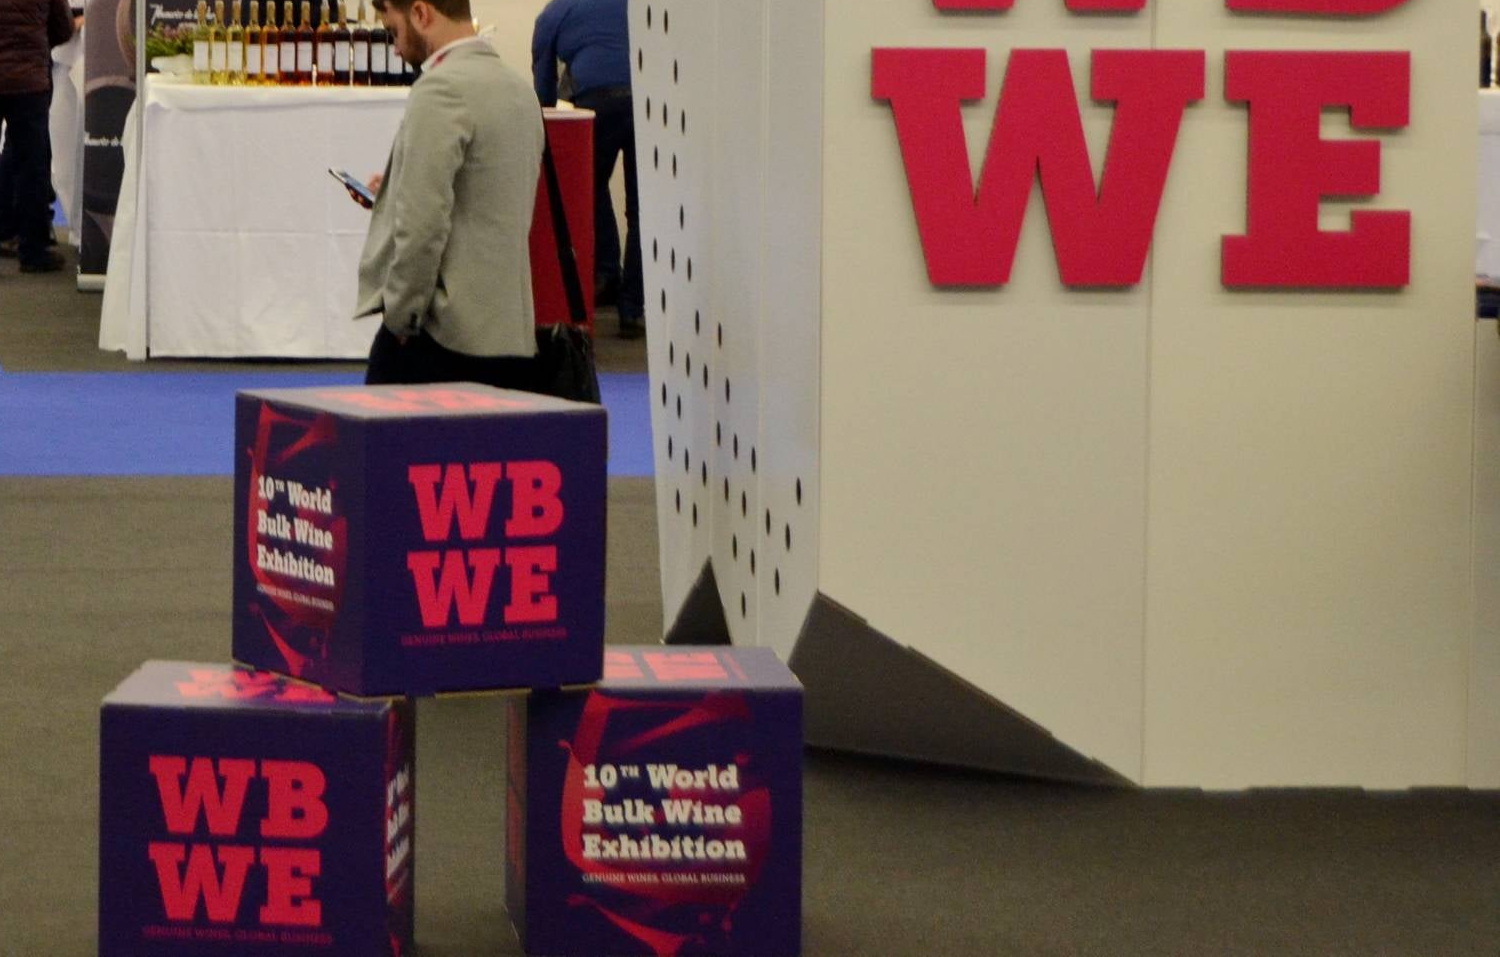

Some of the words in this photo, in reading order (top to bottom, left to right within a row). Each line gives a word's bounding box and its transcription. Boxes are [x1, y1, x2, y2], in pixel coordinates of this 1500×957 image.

[871, 46, 1412, 289] WE
[257, 475, 285, 501] 10TH
[287, 480, 332, 515] World
[408, 460, 564, 542] WB
[257, 509, 291, 540] Bulk
[293, 516, 333, 551] Wine
[257, 544, 335, 587] Exhibition
[407, 545, 558, 628] WE
[149, 754, 329, 839] WB
[583, 763, 639, 788] 10TH
[646, 763, 739, 789] World
[582, 798, 655, 824] Bulk
[660, 798, 743, 824] Wine
[582, 833, 747, 859] Exhibition
[148, 840, 323, 927] WE
[582, 872, 625, 884] GENUINE
[661, 872, 698, 884] GLOBAL
[701, 872, 746, 884] BUSINESS
